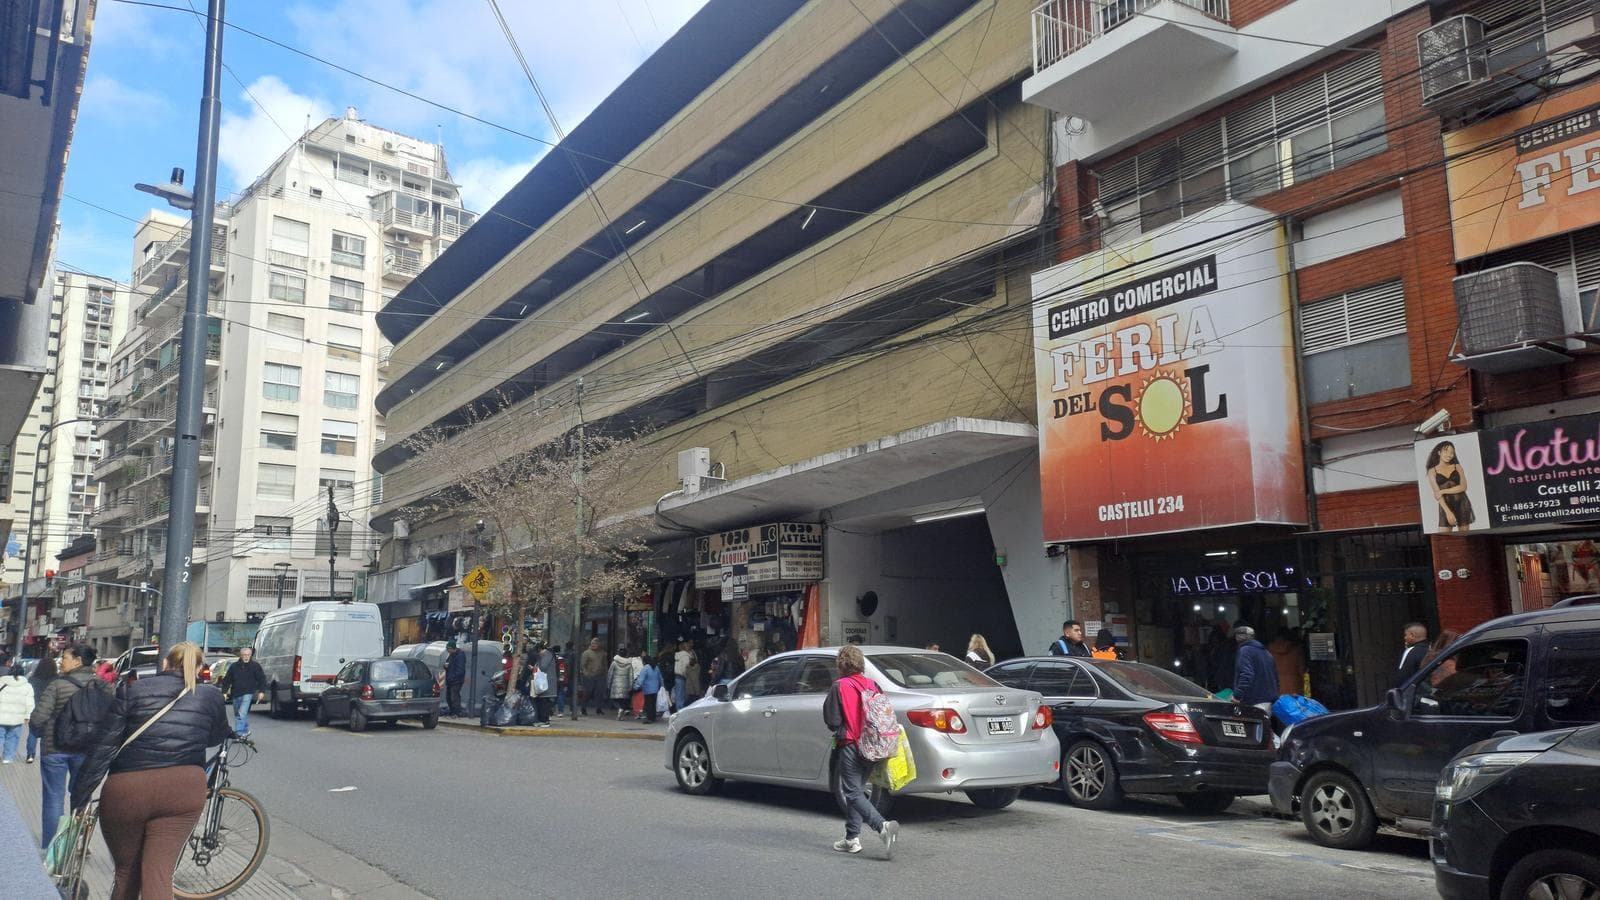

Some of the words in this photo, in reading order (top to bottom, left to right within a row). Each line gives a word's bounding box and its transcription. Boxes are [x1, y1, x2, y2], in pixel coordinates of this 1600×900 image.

[1051, 297, 1110, 333] CENTRO
[1114, 263, 1215, 314] COMERCIAL
[1050, 305, 1225, 393] FERIA
[1053, 392, 1097, 419] DEL
[1098, 363, 1228, 443] SOL
[1509, 466, 1600, 484] naturalmente
[1537, 480, 1591, 496] Castelli
[1098, 496, 1155, 523] CASTELLI
[1157, 494, 1185, 515] 234
[1494, 504, 1511, 513] Tel:
[1512, 499, 1561, 511] 4863-7923
[1502, 512, 1533, 522] E-mail:
[1195, 575, 1239, 592] DEL
